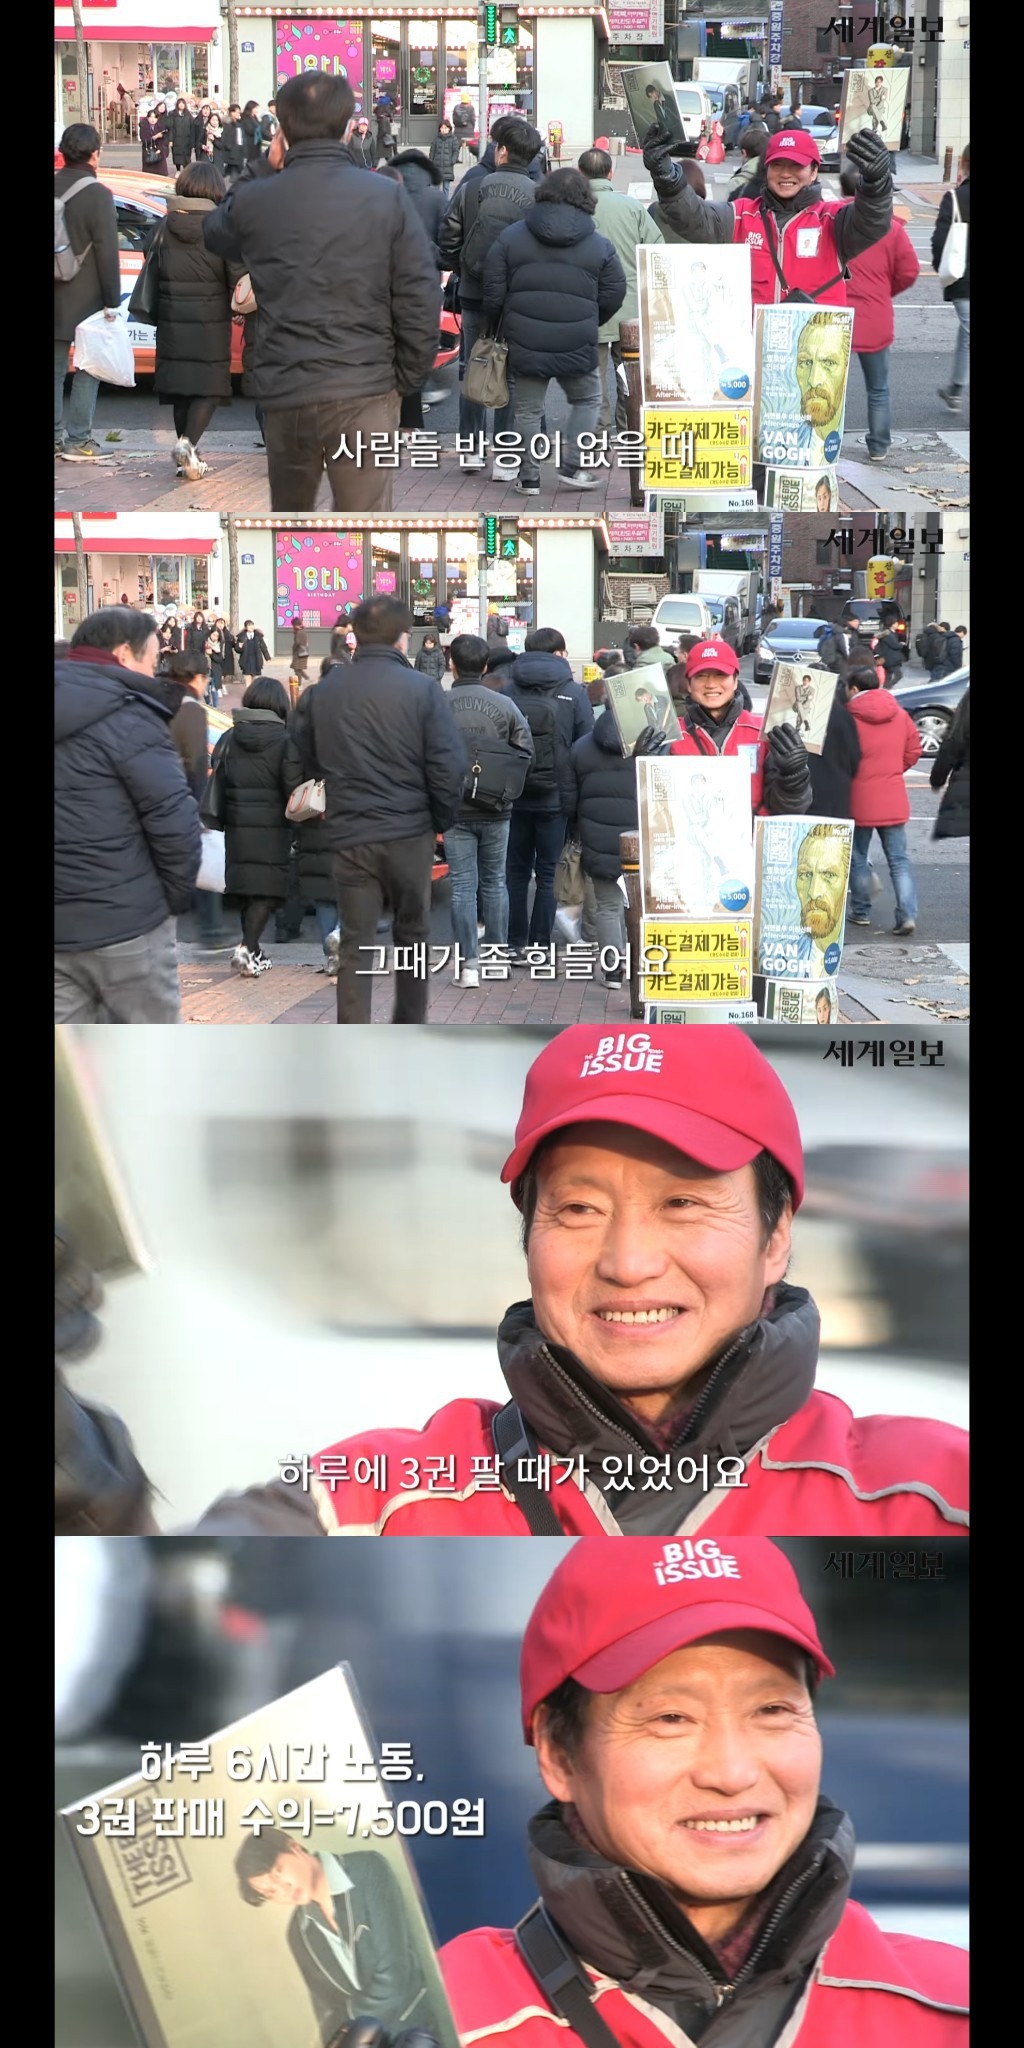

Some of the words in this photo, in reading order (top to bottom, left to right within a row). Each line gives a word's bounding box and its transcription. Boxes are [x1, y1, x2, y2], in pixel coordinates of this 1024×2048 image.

[748, 231, 762, 240] BIG
[763, 431, 798, 445] VAN
[762, 446, 811, 461] GOGH
[647, 461, 739, 479] 카드결제가능
[782, 479, 790, 494] BIG
[789, 480, 801, 511] ISSUE
[292, 566, 348, 591] 18th
[763, 943, 798, 957] VAN
[762, 958, 811, 973] GOGH
[647, 973, 739, 991] 카드결제가능
[782, 991, 790, 1006] BIG
[789, 992, 801, 1023] ISSUE
[596, 1032, 652, 1057] BIG
[579, 1052, 664, 1078] ISSUE
[662, 1538, 720, 1564] BIG
[654, 1559, 742, 1586] ISSUE
[122, 1845, 153, 1896] THE
